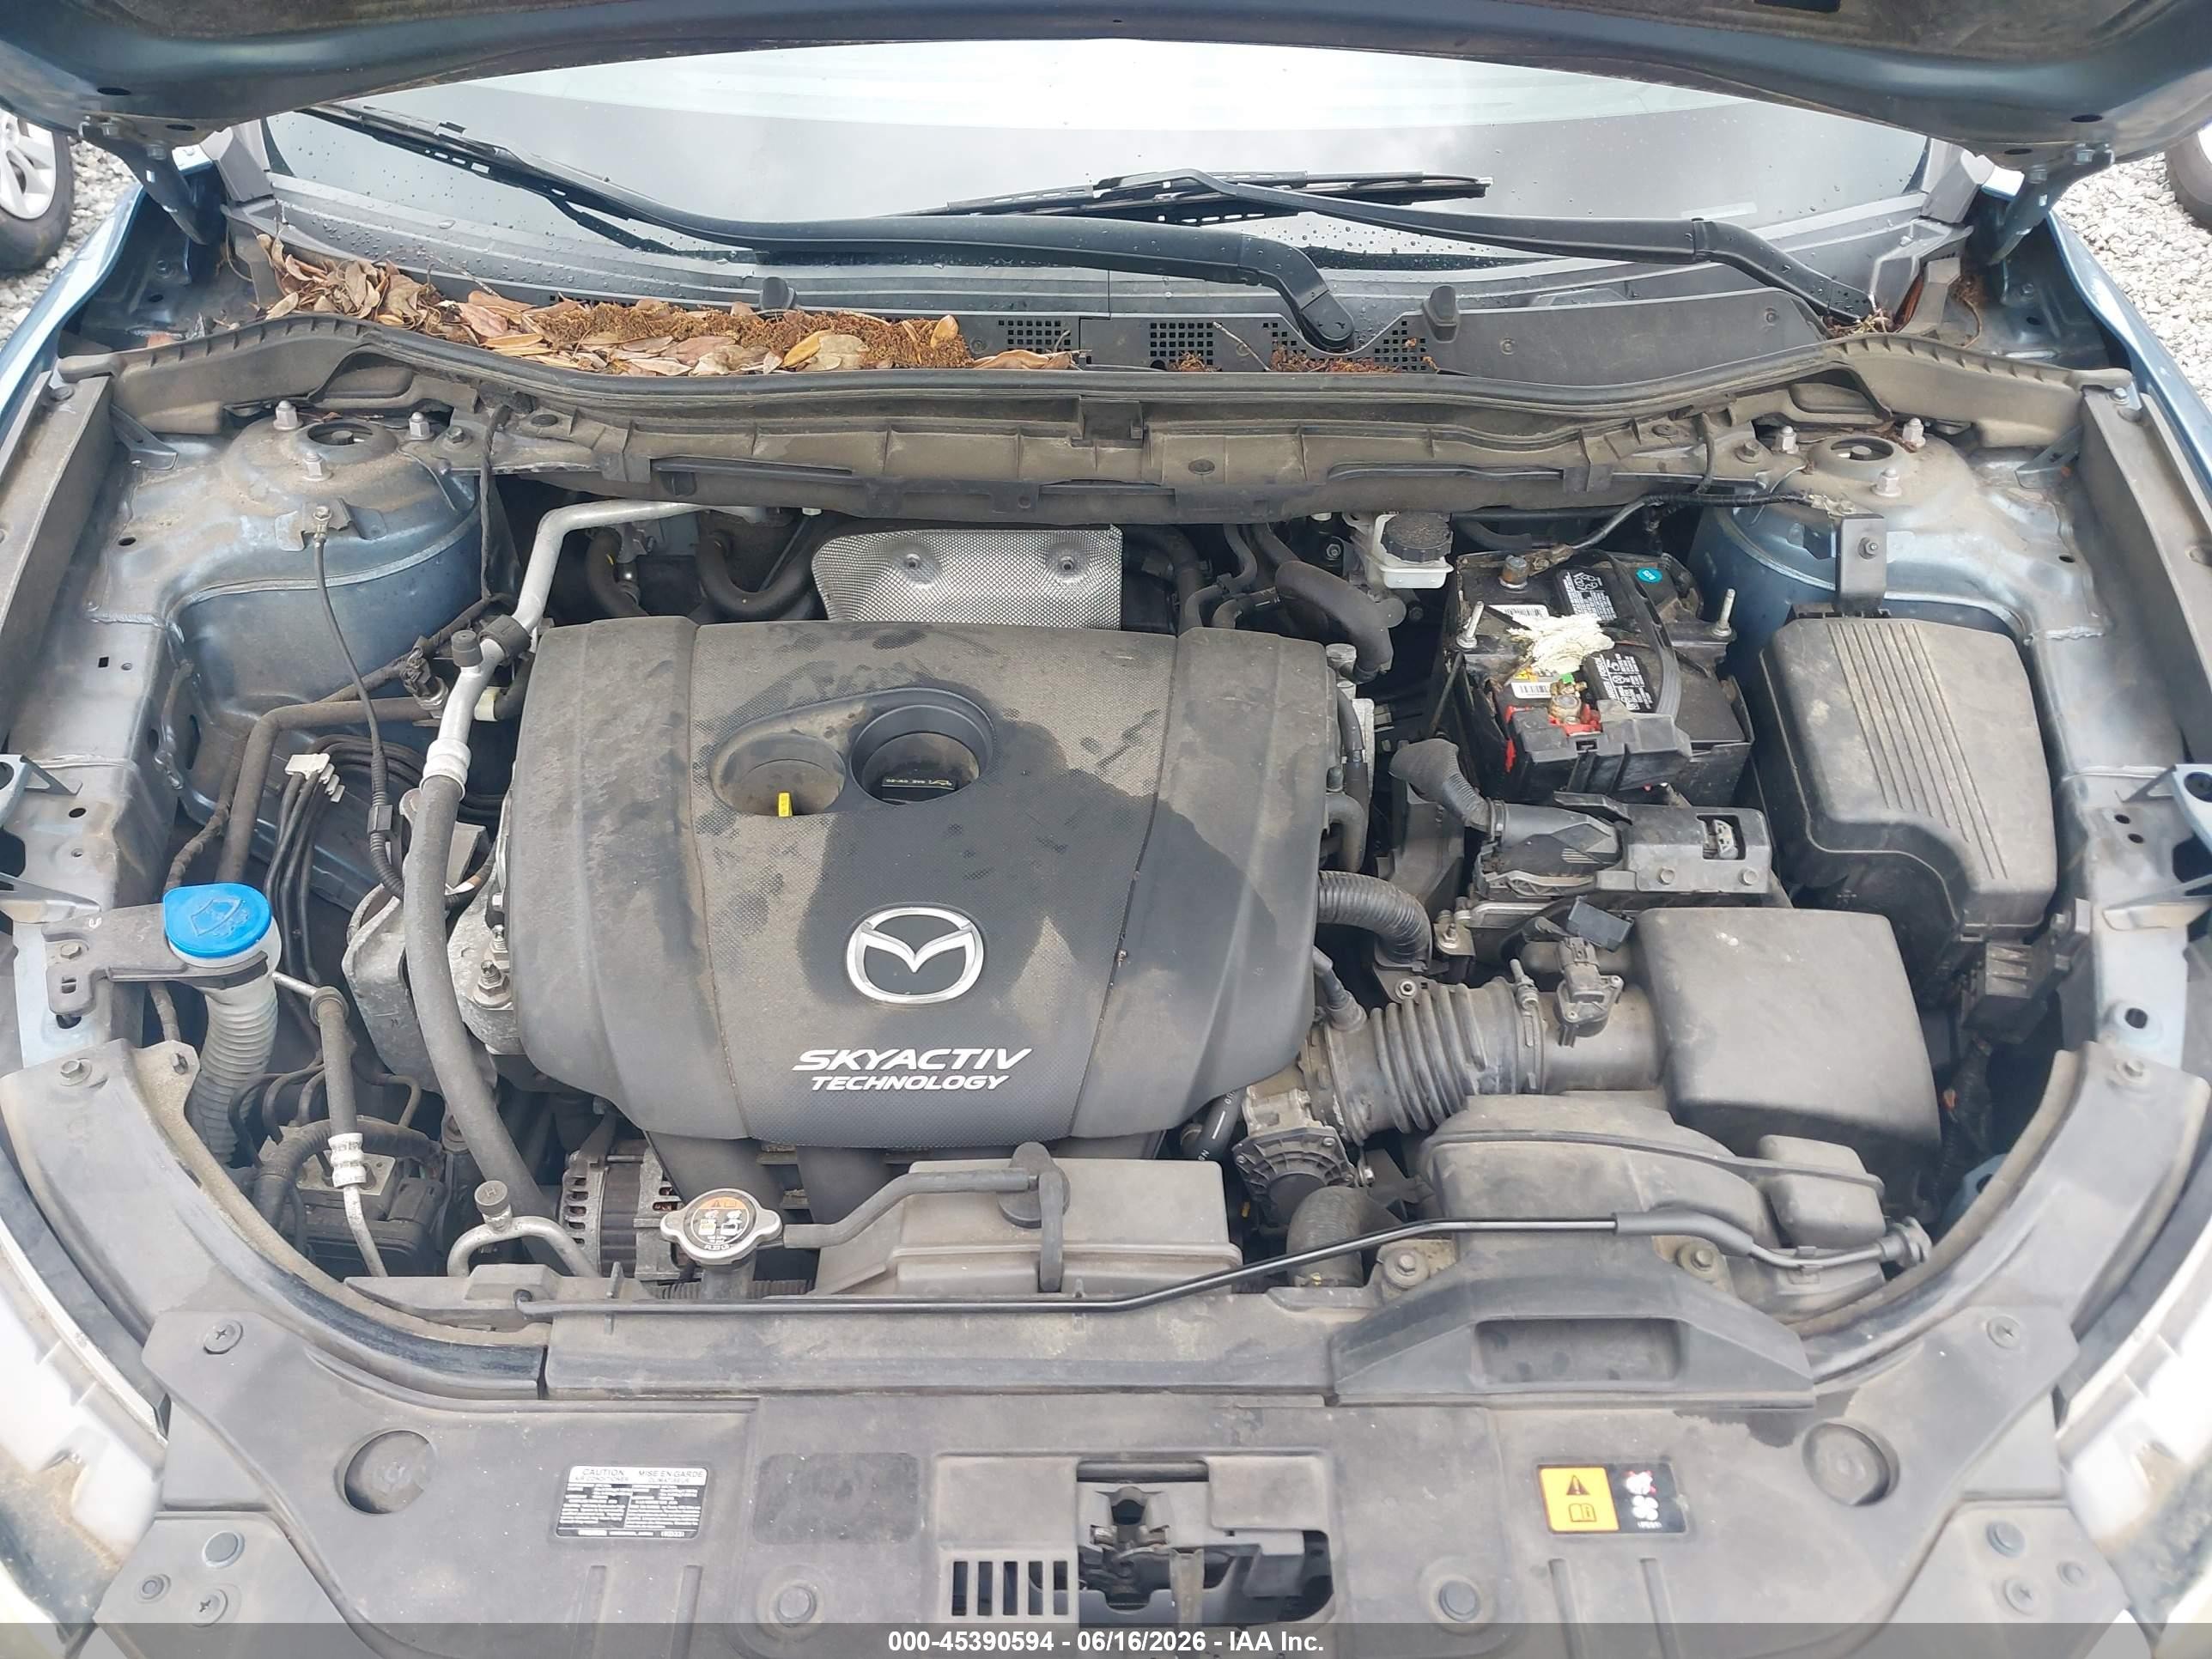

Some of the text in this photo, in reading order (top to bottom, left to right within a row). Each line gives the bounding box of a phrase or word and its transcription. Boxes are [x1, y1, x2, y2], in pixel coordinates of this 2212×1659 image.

[792, 1048, 1032, 1071] SKYACTIV
[811, 1075, 1010, 1091] TECHNOLOGY
[485, 1186, 496, 1197] H
